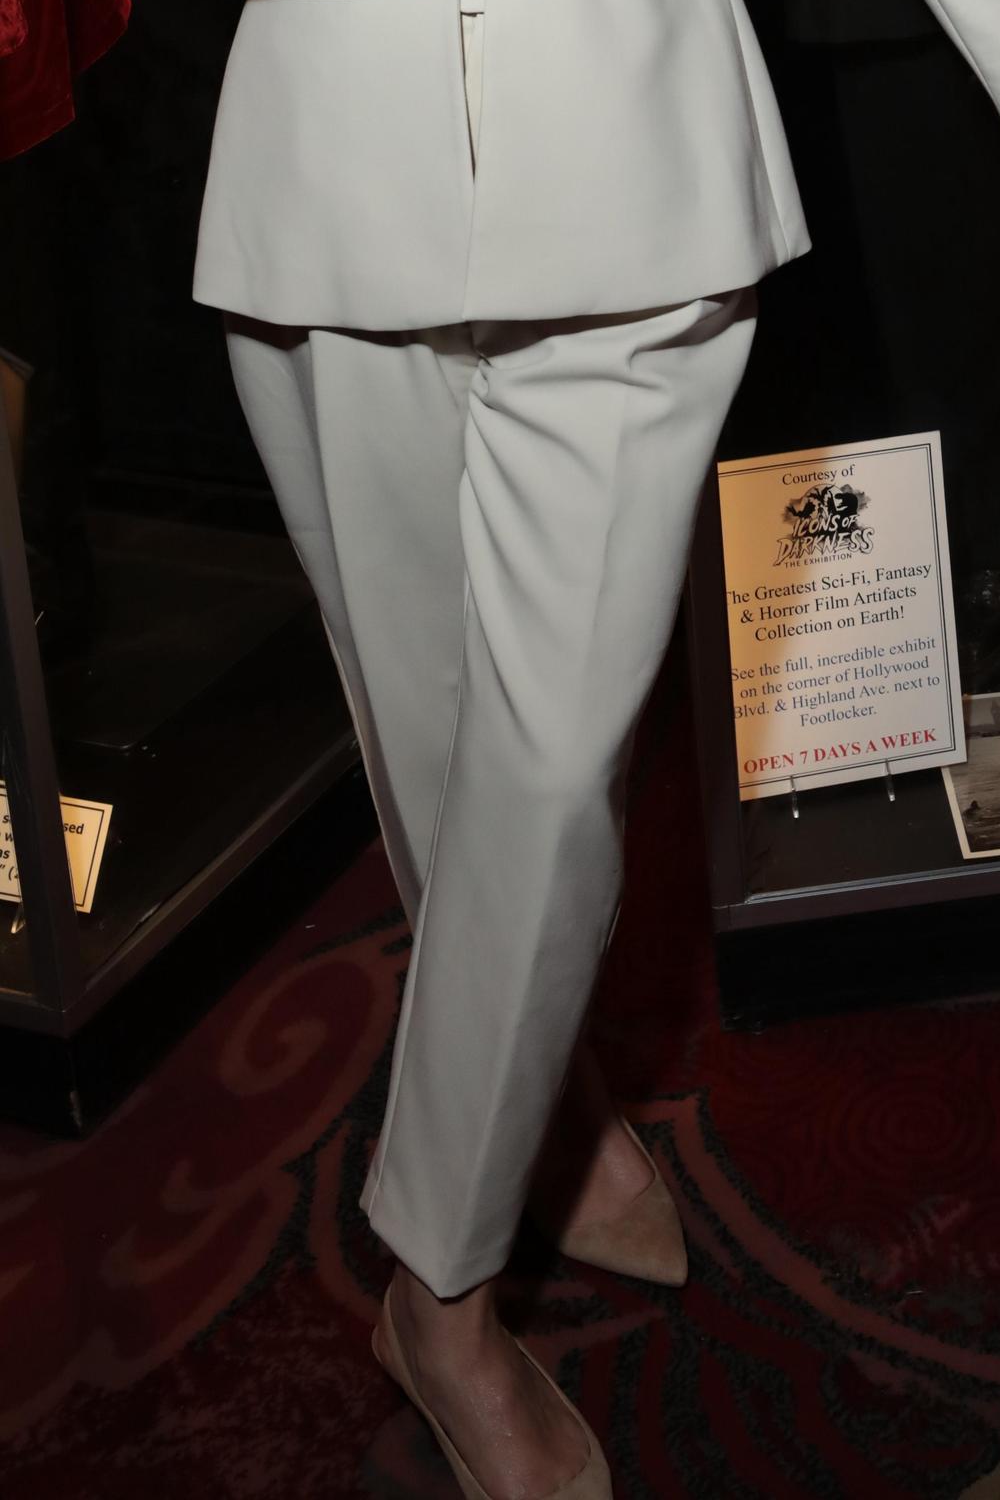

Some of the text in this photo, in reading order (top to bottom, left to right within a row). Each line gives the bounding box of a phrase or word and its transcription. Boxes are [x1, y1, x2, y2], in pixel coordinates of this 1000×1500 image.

[782, 464, 855, 486] Courtesy of
[792, 514, 859, 537] ICONS OF
[773, 527, 875, 567] DARKNESS
[785, 553, 852, 569] THE EXHIBITION
[755, 581, 816, 600] Greatest
[822, 571, 871, 590] Sci-Fi,
[876, 564, 932, 581] Fantasy
[740, 585, 917, 624] & Horror Film Artifacts
[755, 606, 905, 642] Collection on Earth!
[731, 637, 936, 681] See the full, incredible exhibit
[740, 656, 929, 699] on the corner of Hollywood
[735, 675, 941, 719] Blvd. & Highland Ave. next to
[800, 705, 878, 727] Footlocker.
[744, 728, 937, 774] OPEN 7 DAYS A WEEK
